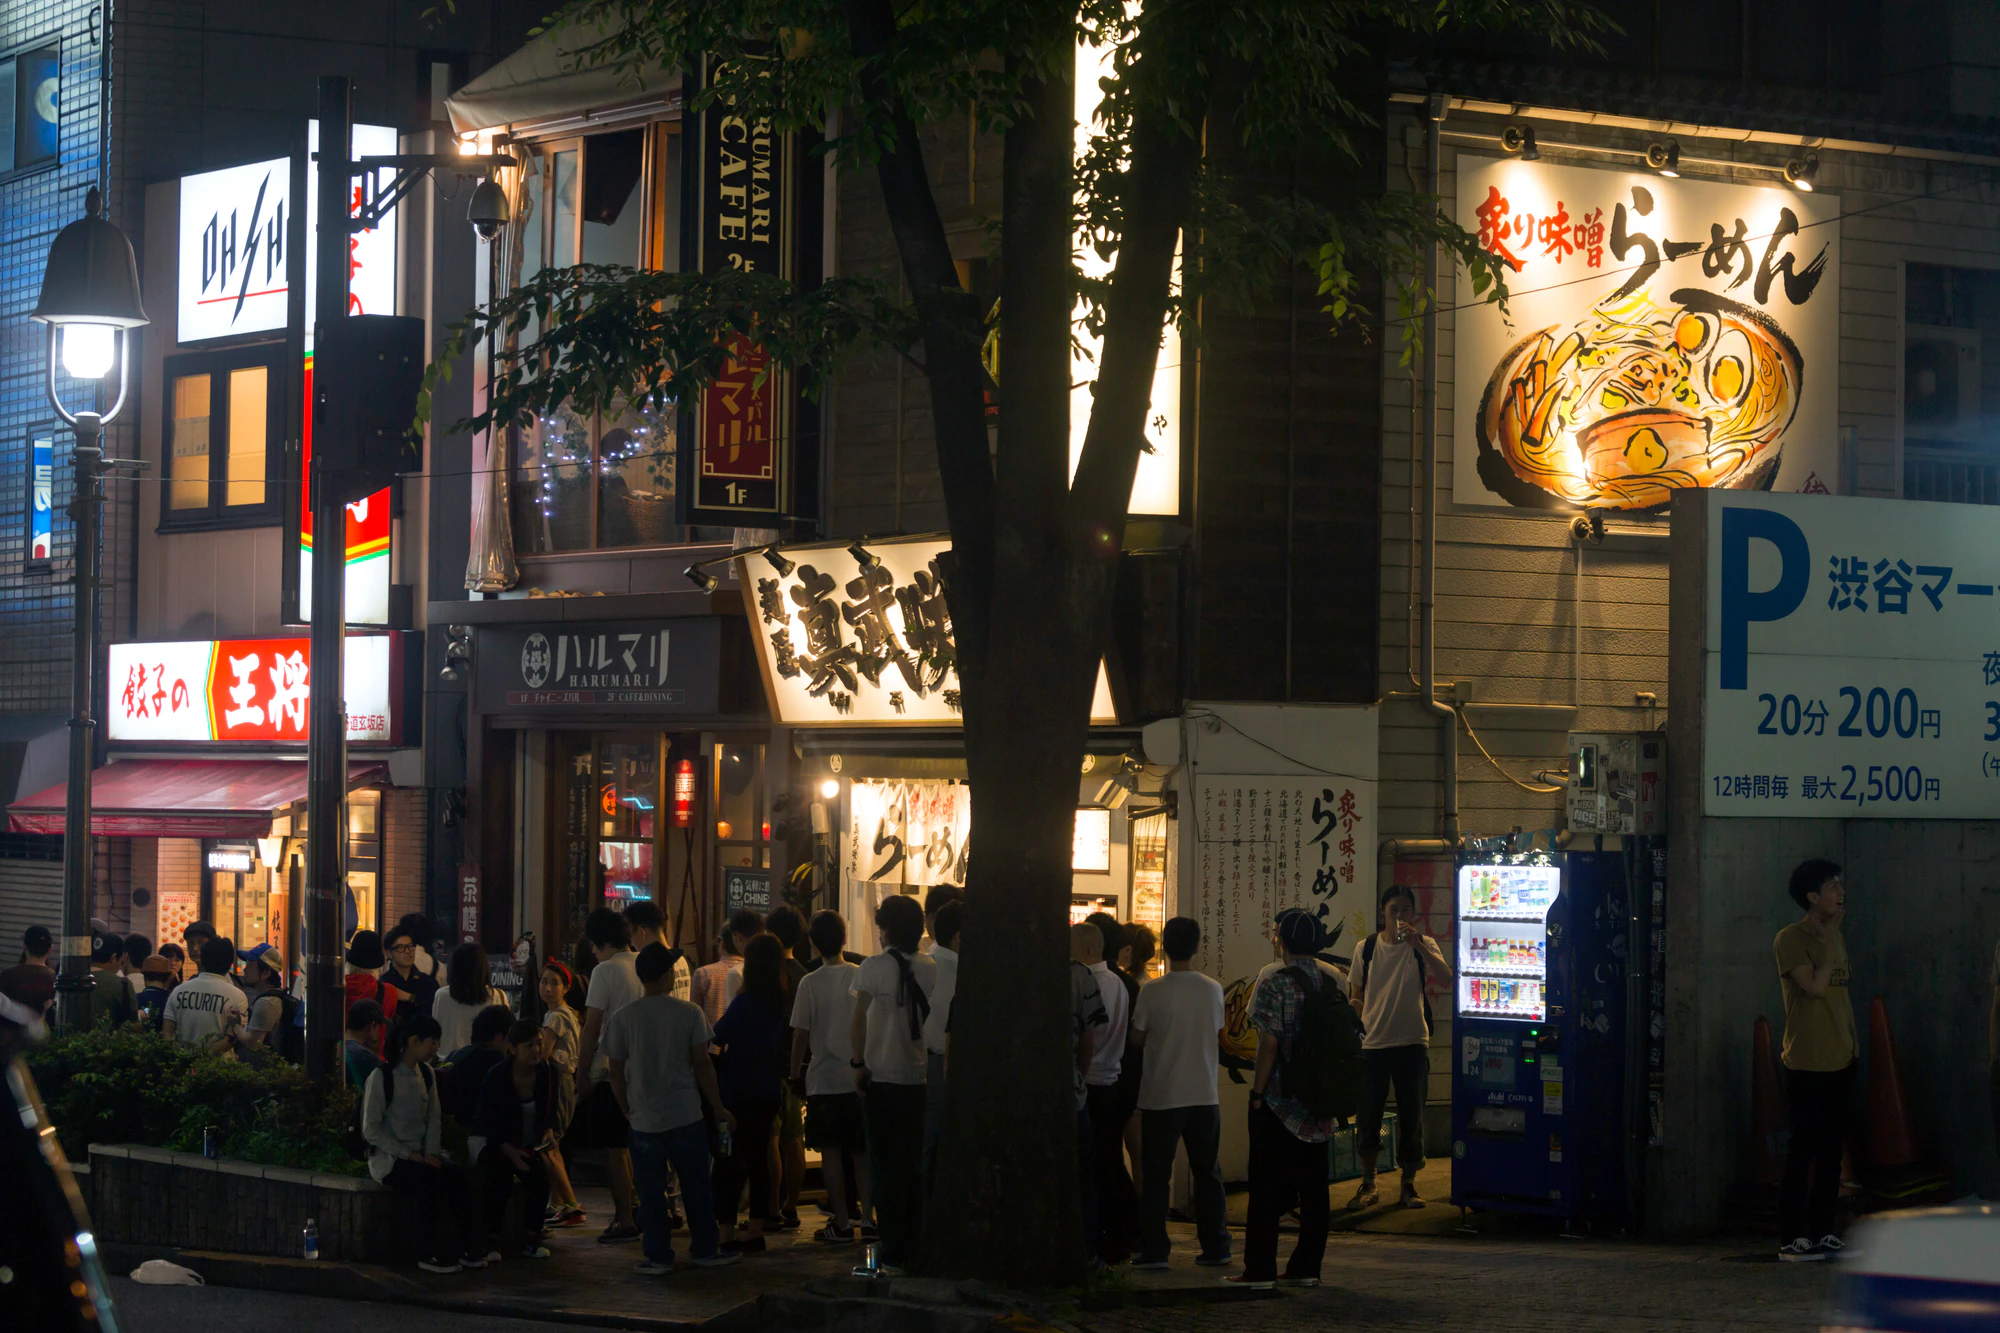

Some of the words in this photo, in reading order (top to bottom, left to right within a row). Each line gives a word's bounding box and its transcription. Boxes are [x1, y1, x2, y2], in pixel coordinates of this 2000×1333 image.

[718, 114, 748, 242] CAFE
[1474, 185, 1606, 274] 炙り味噌
[1599, 185, 1830, 307] らーめん
[724, 481, 748, 506] 1F
[1719, 506, 1811, 690] P
[1827, 554, 2000, 616] 渋谷マー
[555, 628, 670, 687] ハルマリ
[569, 673, 651, 688] HARUMARI
[121, 662, 190, 719] 餃子の
[224, 649, 311, 732] 王将
[1756, 692, 1830, 737] 20分
[1837, 686, 1942, 740] 200円
[1712, 774, 1790, 801] 12時間毎
[1337, 788, 1364, 884] 炙り味噌
[176, 990, 230, 1015] SECURITY
